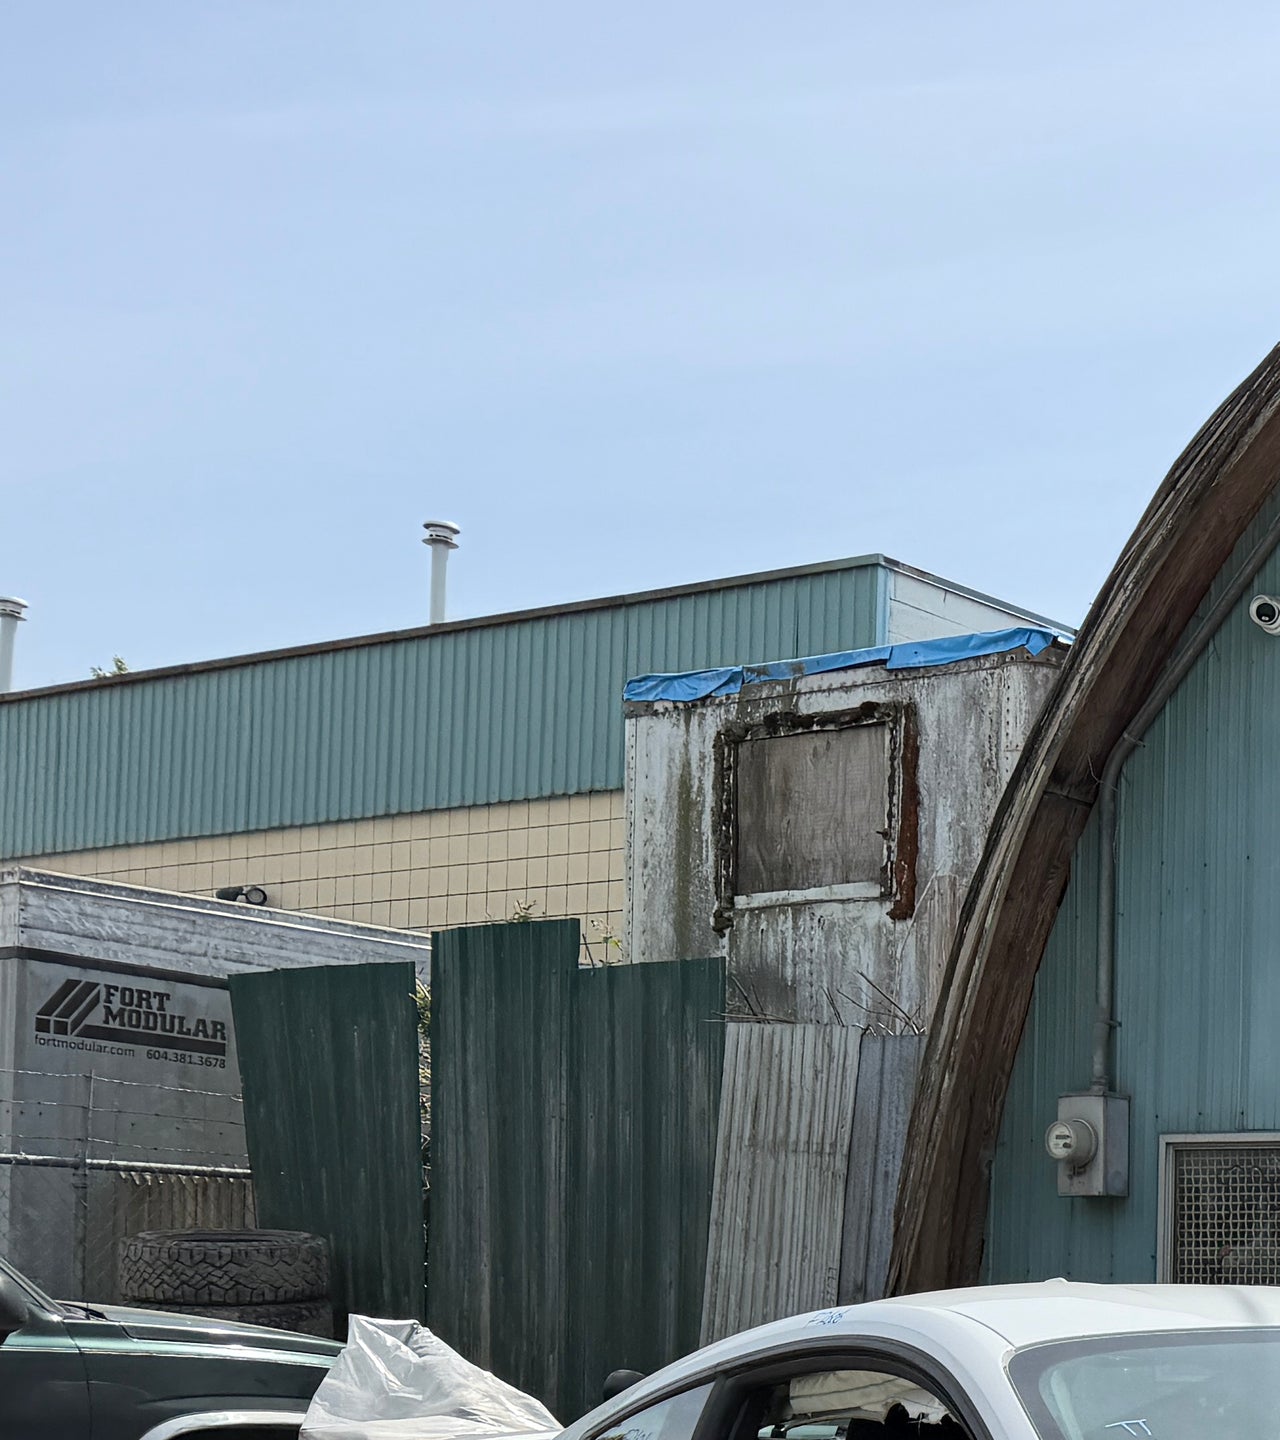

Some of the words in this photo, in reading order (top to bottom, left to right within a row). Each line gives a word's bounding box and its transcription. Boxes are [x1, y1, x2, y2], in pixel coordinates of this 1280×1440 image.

[103, 983, 171, 1013] FORT
[103, 1005, 227, 1042] MODULAR
[35, 1034, 136, 1058] fortmodular.com
[146, 1049, 227, 1070] 604.381.3678
